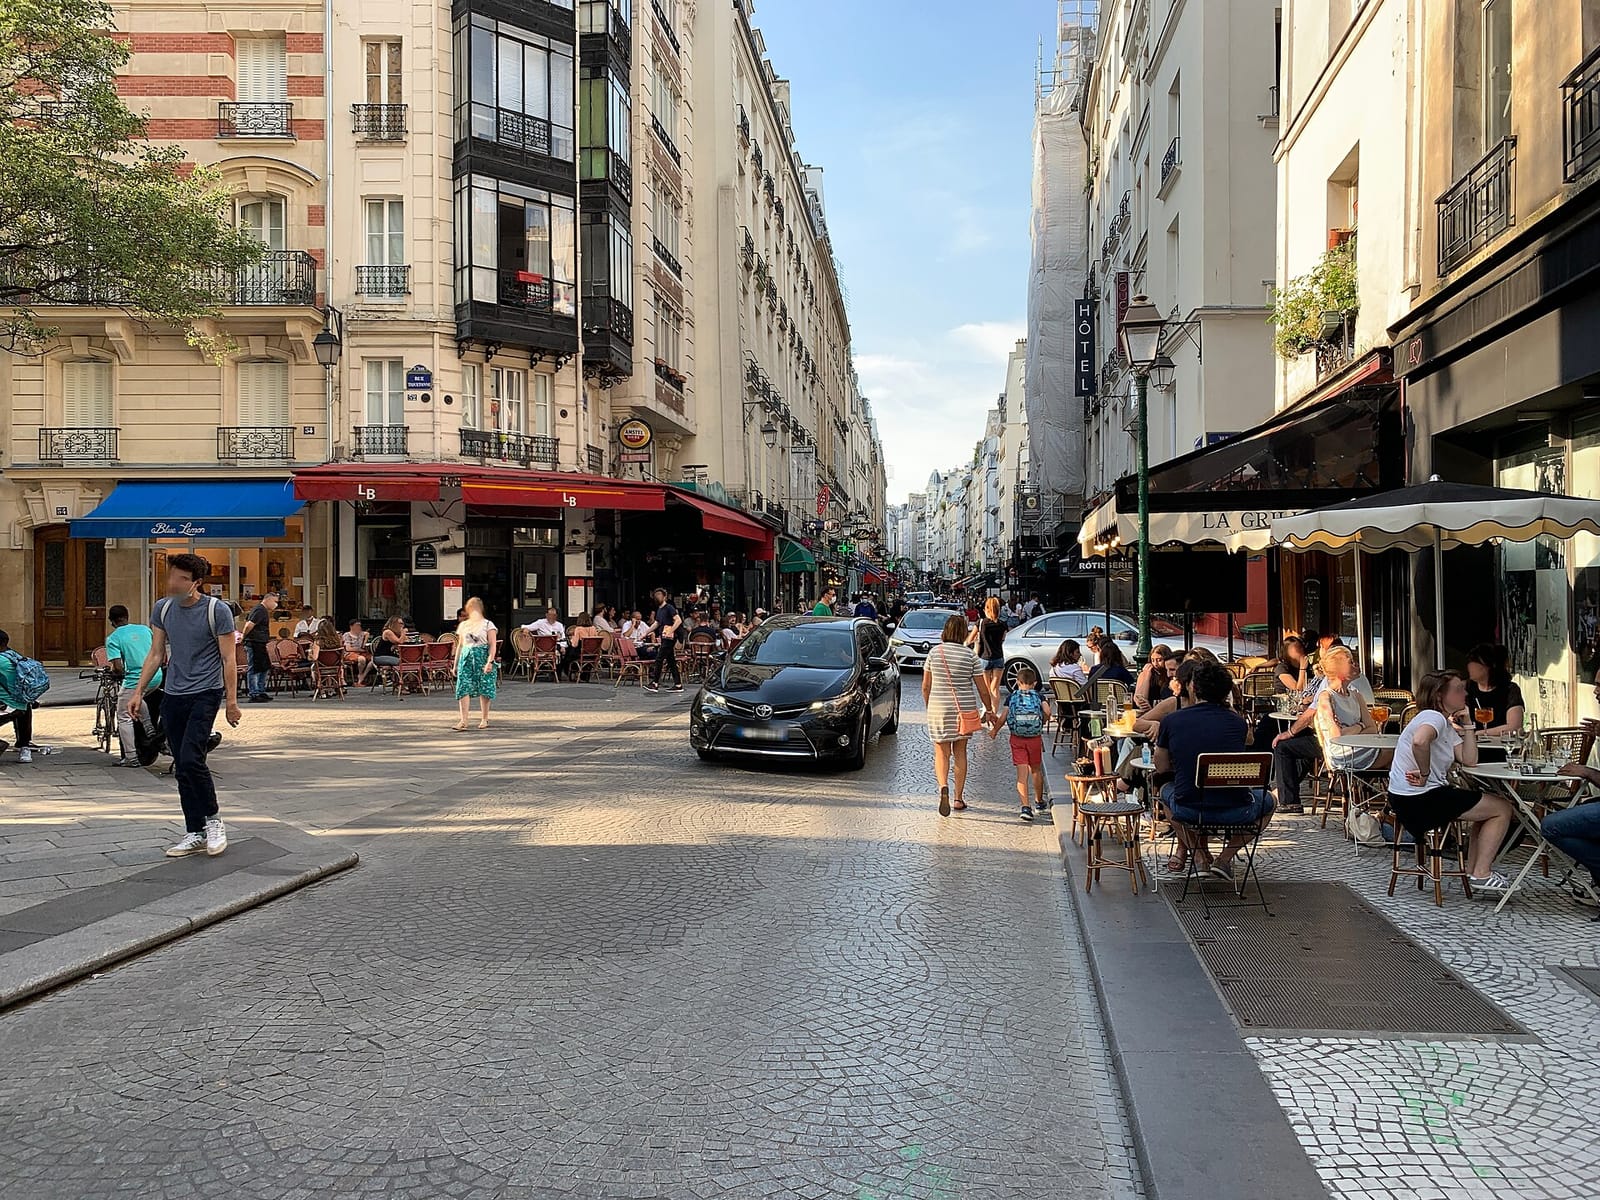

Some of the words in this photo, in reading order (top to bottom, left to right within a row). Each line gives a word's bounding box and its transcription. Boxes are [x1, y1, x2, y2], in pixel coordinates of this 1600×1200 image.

[1078, 303, 1092, 392] HÔTEL
[358, 483, 376, 500] LB
[563, 492, 577, 507] LB
[150, 522, 177, 534] Blue
[178, 521, 206, 536] Lemon
[1202, 513, 1230, 529] LA
